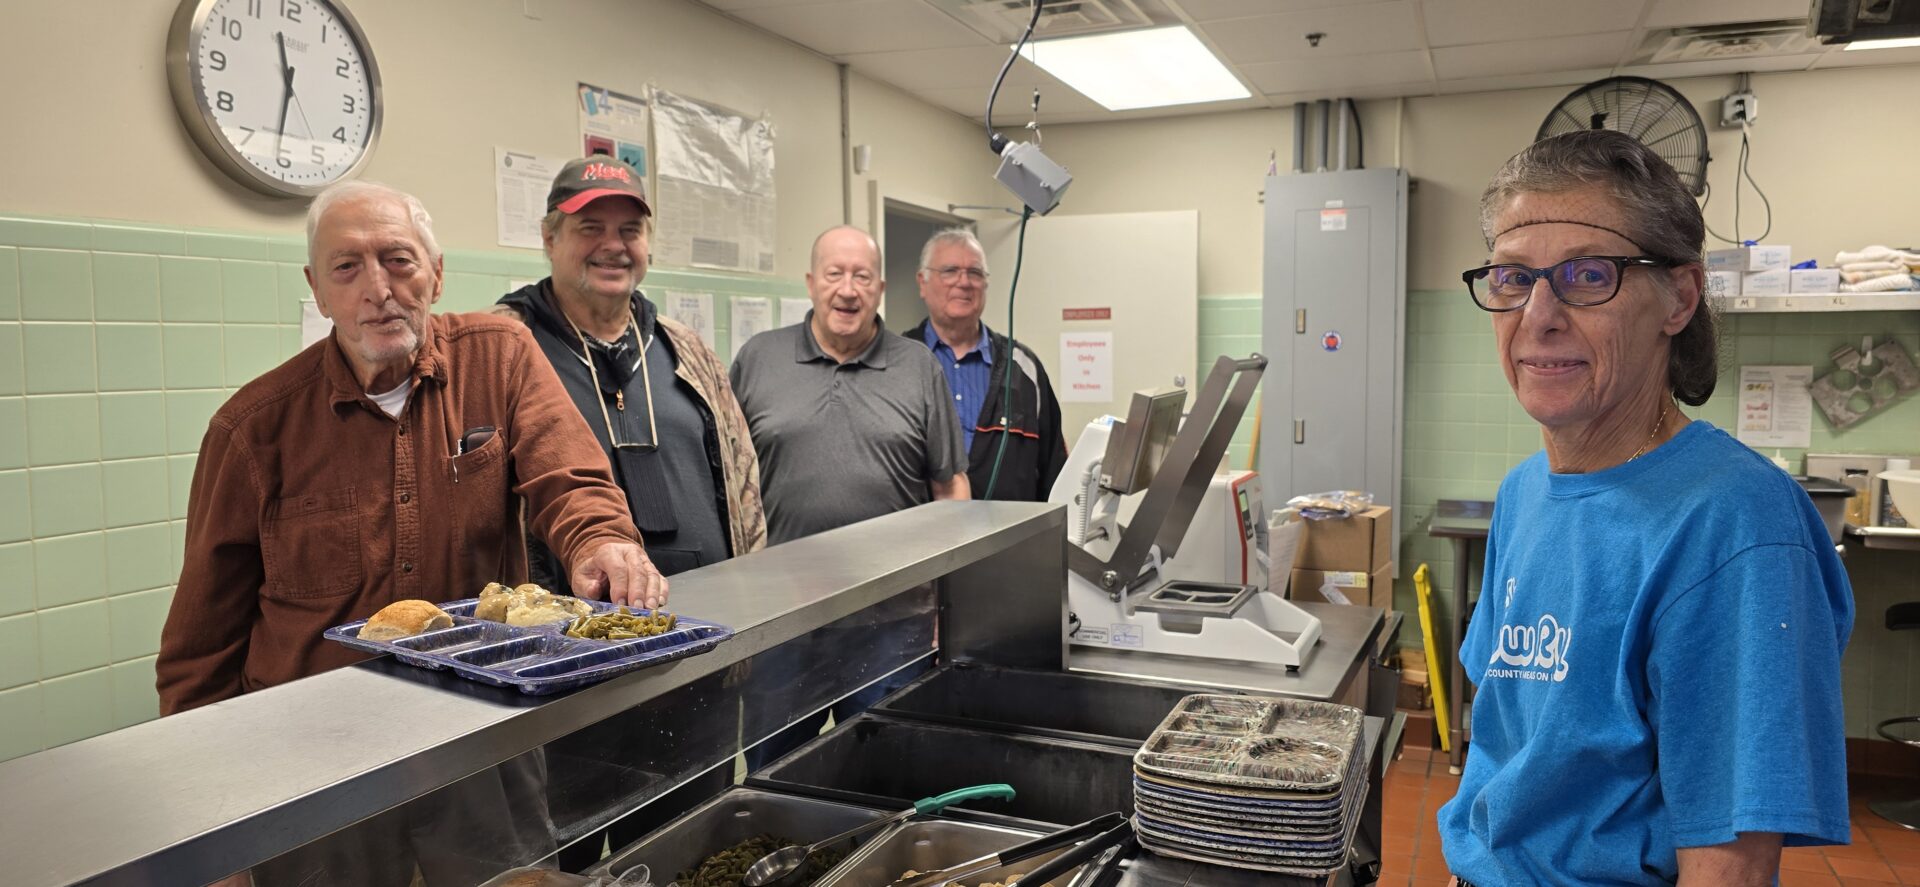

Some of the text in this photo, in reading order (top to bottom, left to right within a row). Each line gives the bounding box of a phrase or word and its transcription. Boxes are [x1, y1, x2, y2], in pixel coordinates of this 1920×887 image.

[247, 0, 261, 19] 11
[279, 0, 302, 23] 12
[221, 16, 242, 41] 10
[321, 25, 327, 43] 1
[209, 50, 227, 72] 9
[335, 57, 350, 79] 2
[216, 90, 235, 112] 8
[342, 94, 355, 114] 3
[239, 126, 255, 146] 7
[332, 126, 347, 144] 4
[276, 149, 291, 169] 6
[311, 145, 325, 166] 5
[1740, 299, 1749, 307] M
[1785, 299, 1792, 307] L
[1832, 297, 1846, 305] XL
[1066, 340, 1106, 348] Employees
[1078, 354, 1095, 363] Only
[1488, 669, 1523, 679] COUNTY
[1536, 672, 1549, 681] ON
